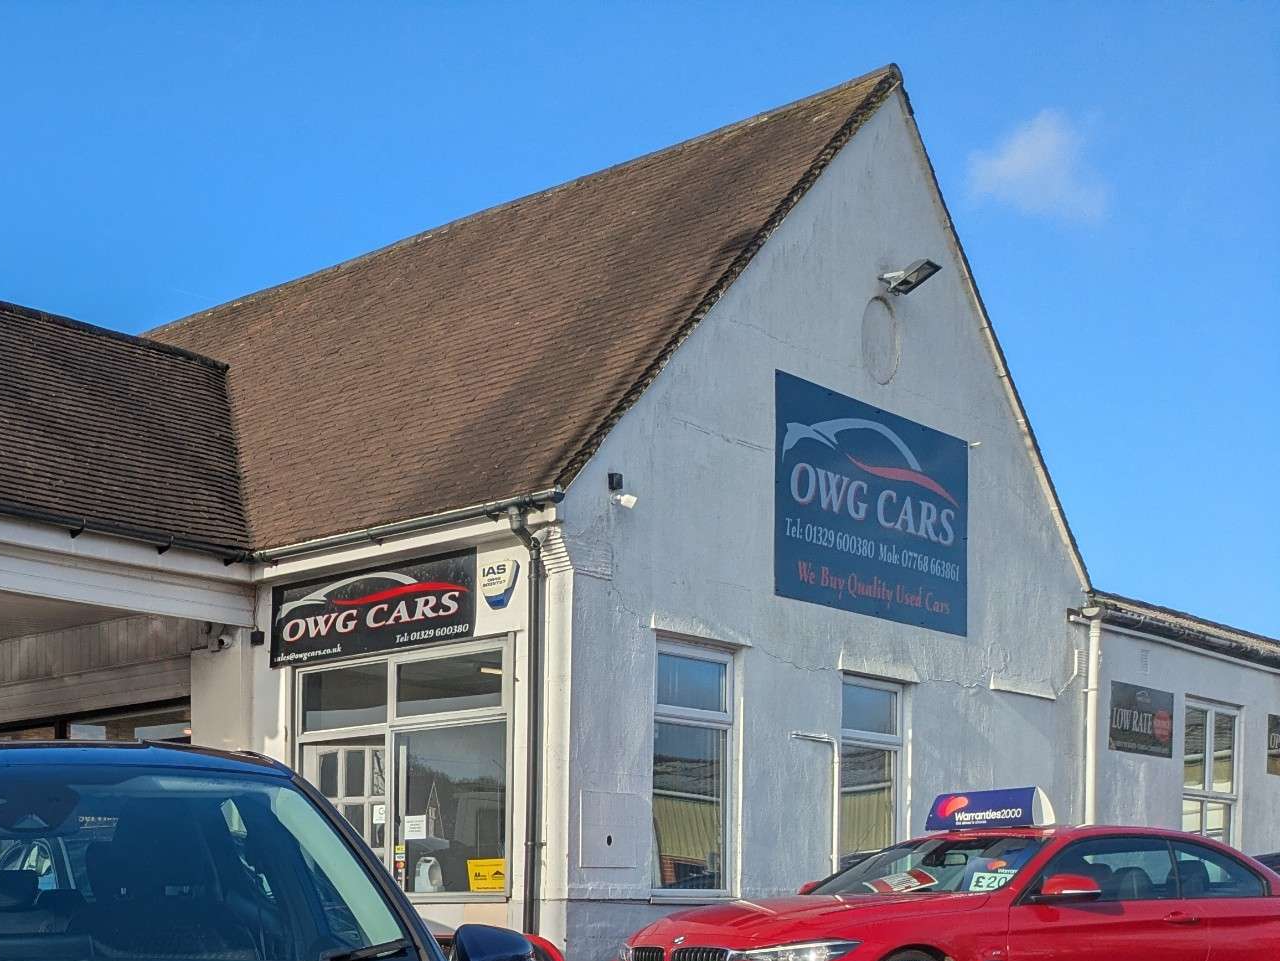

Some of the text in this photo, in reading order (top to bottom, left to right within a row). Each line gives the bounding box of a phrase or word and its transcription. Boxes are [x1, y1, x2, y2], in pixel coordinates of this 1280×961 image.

[790, 462, 956, 547] OWG CARS
[785, 517, 960, 582] Tel: 01329 600380 Mob: 07768 663861
[482, 564, 506, 577] IAS
[798, 560, 951, 615] We Buy Quality Used Cars
[282, 591, 460, 643] OWG CARS
[395, 623, 469, 644] Tel: 01329 600380
[1112, 707, 1132, 731] LOW
[1132, 710, 1152, 735] RATE
[954, 808, 1022, 821] Warranties2000
